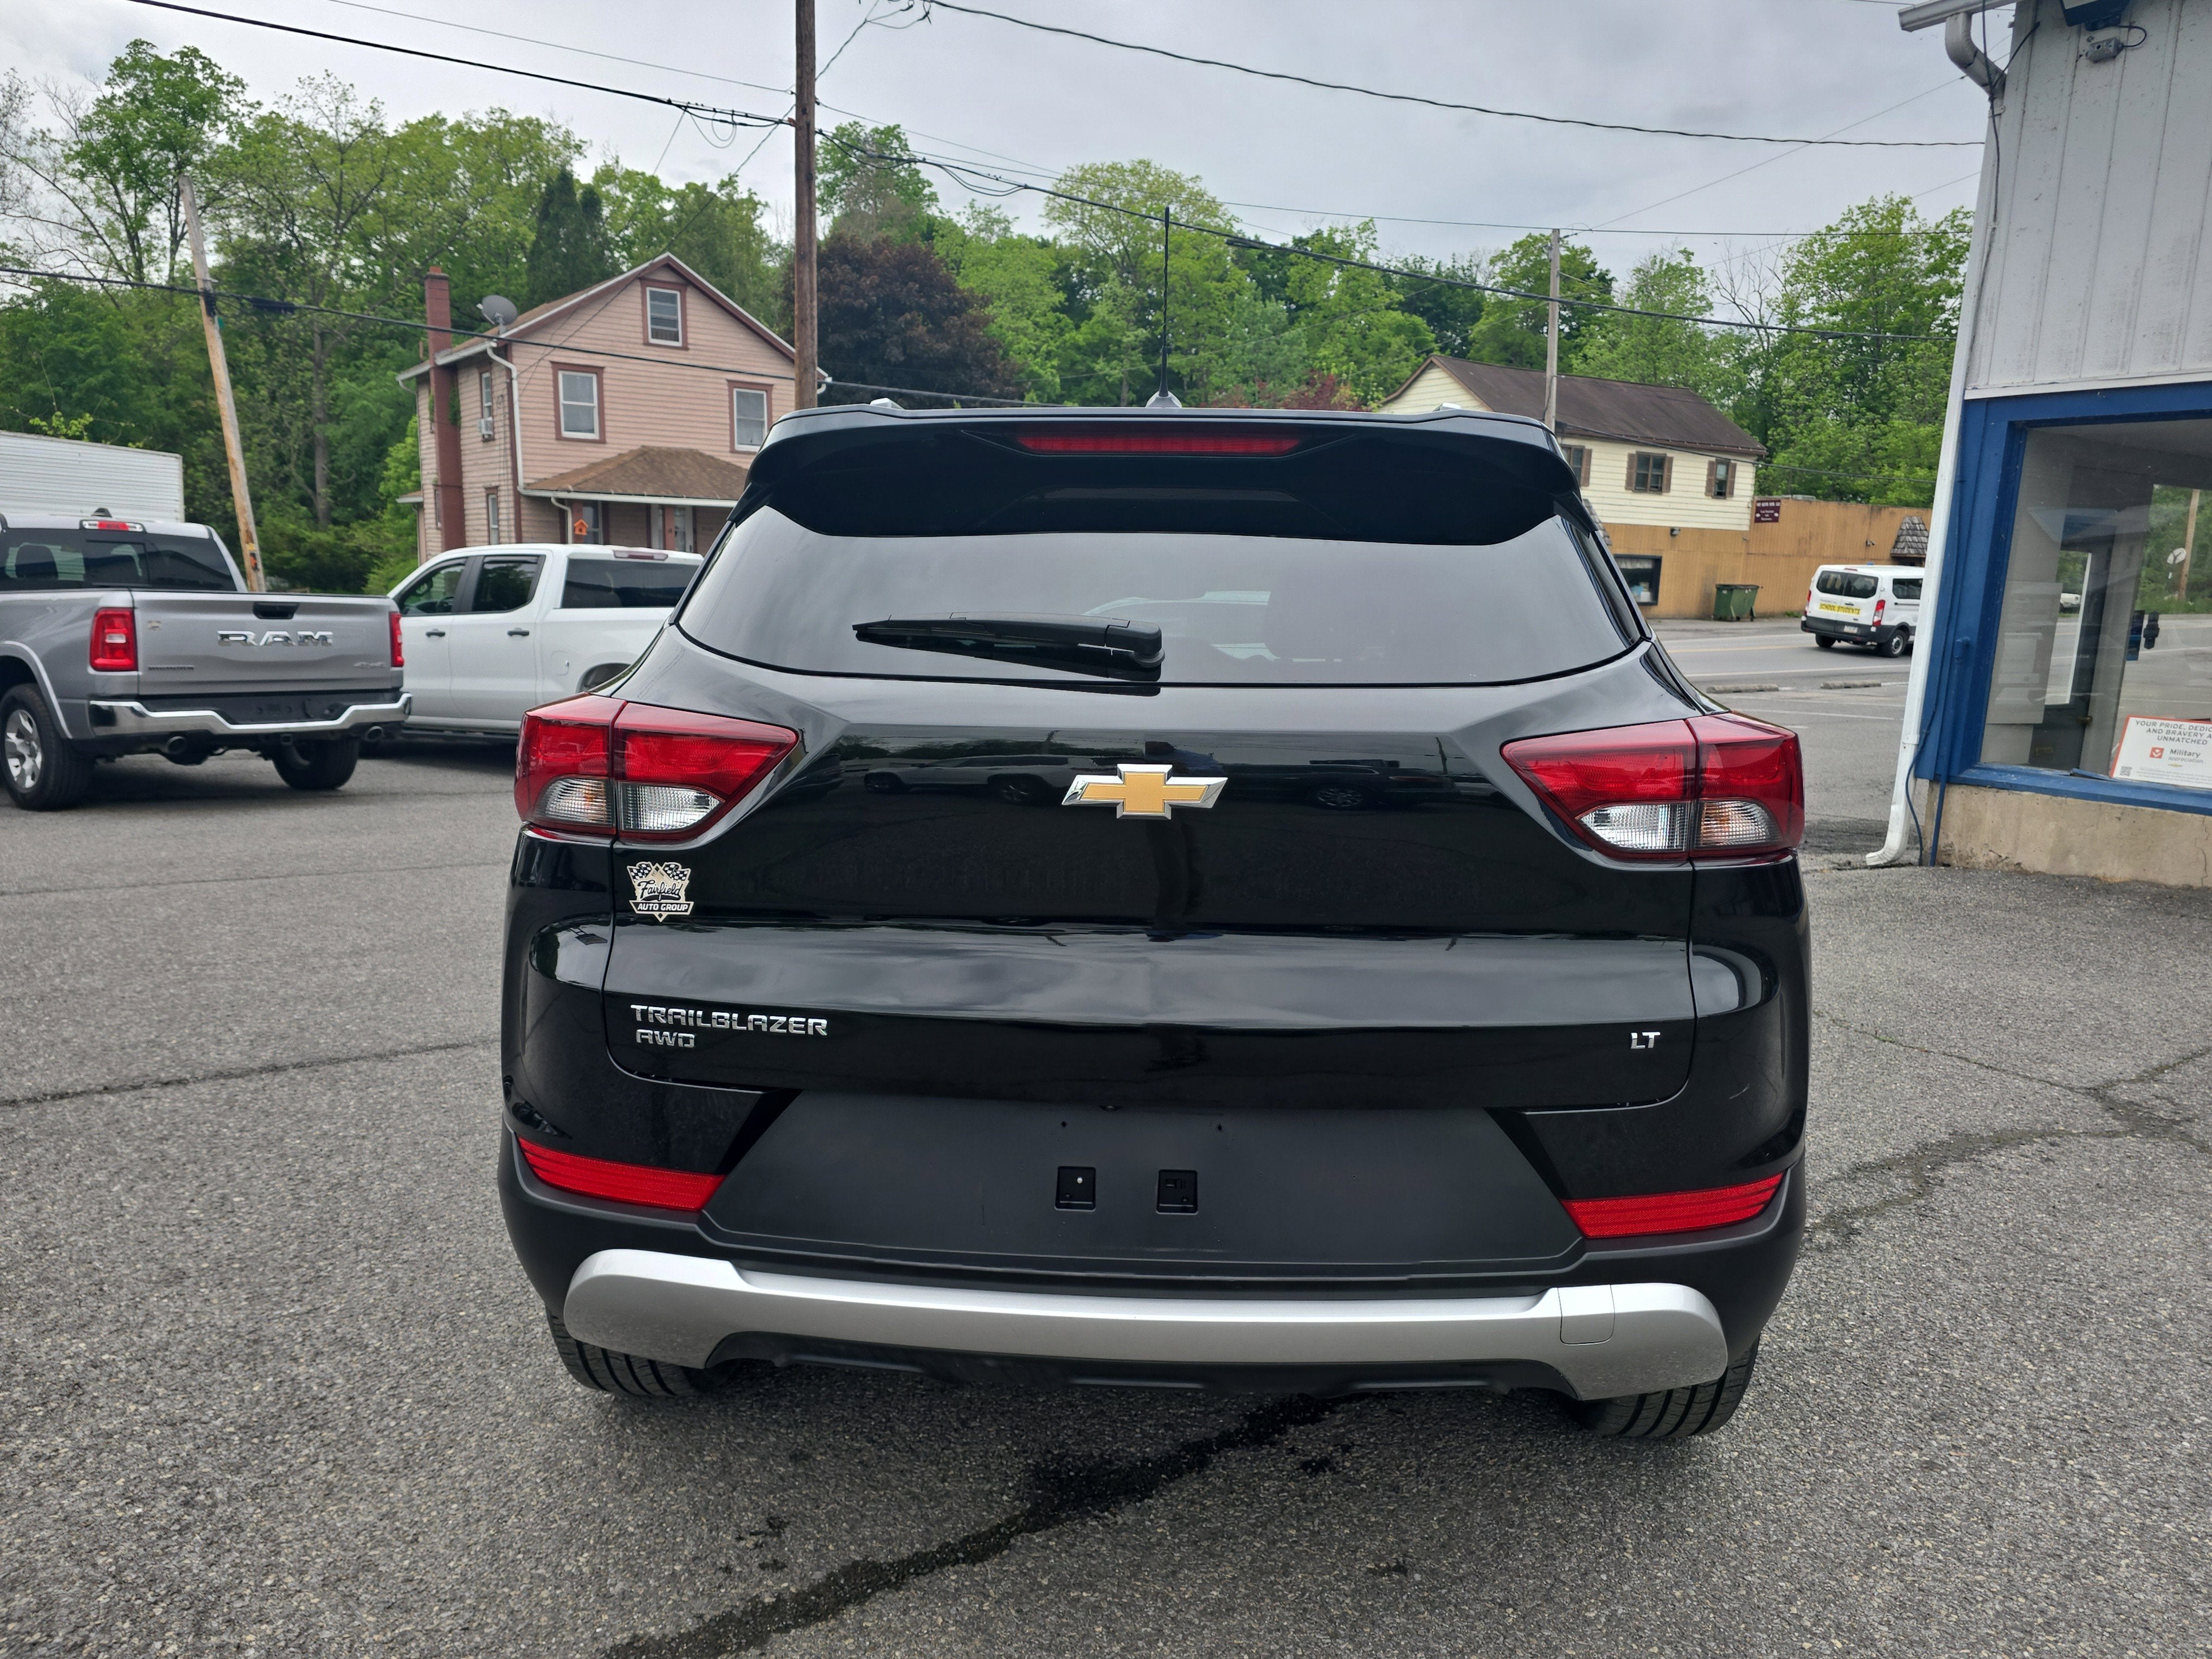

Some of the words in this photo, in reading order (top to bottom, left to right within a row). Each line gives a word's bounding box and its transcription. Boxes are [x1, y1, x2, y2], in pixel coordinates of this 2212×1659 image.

[1819, 602, 1836, 612] SCHOOL
[1836, 606, 1861, 615] STUDENTS
[217, 630, 333, 647] RAM
[2135, 719, 2157, 728] YOUR
[2159, 722, 2185, 730] PRIDE,
[2157, 735, 2208, 745] UNMATCHED
[2165, 729, 2205, 738] BRAVERY
[2170, 748, 2201, 759] Military
[637, 879, 683, 901] Fairfield
[636, 903, 659, 911] AUTO
[660, 903, 689, 911] GROUP
[630, 1004, 827, 1036] TRAILBLAZER
[635, 1029, 696, 1049] AWD
[1630, 1031, 1661, 1049] LT
